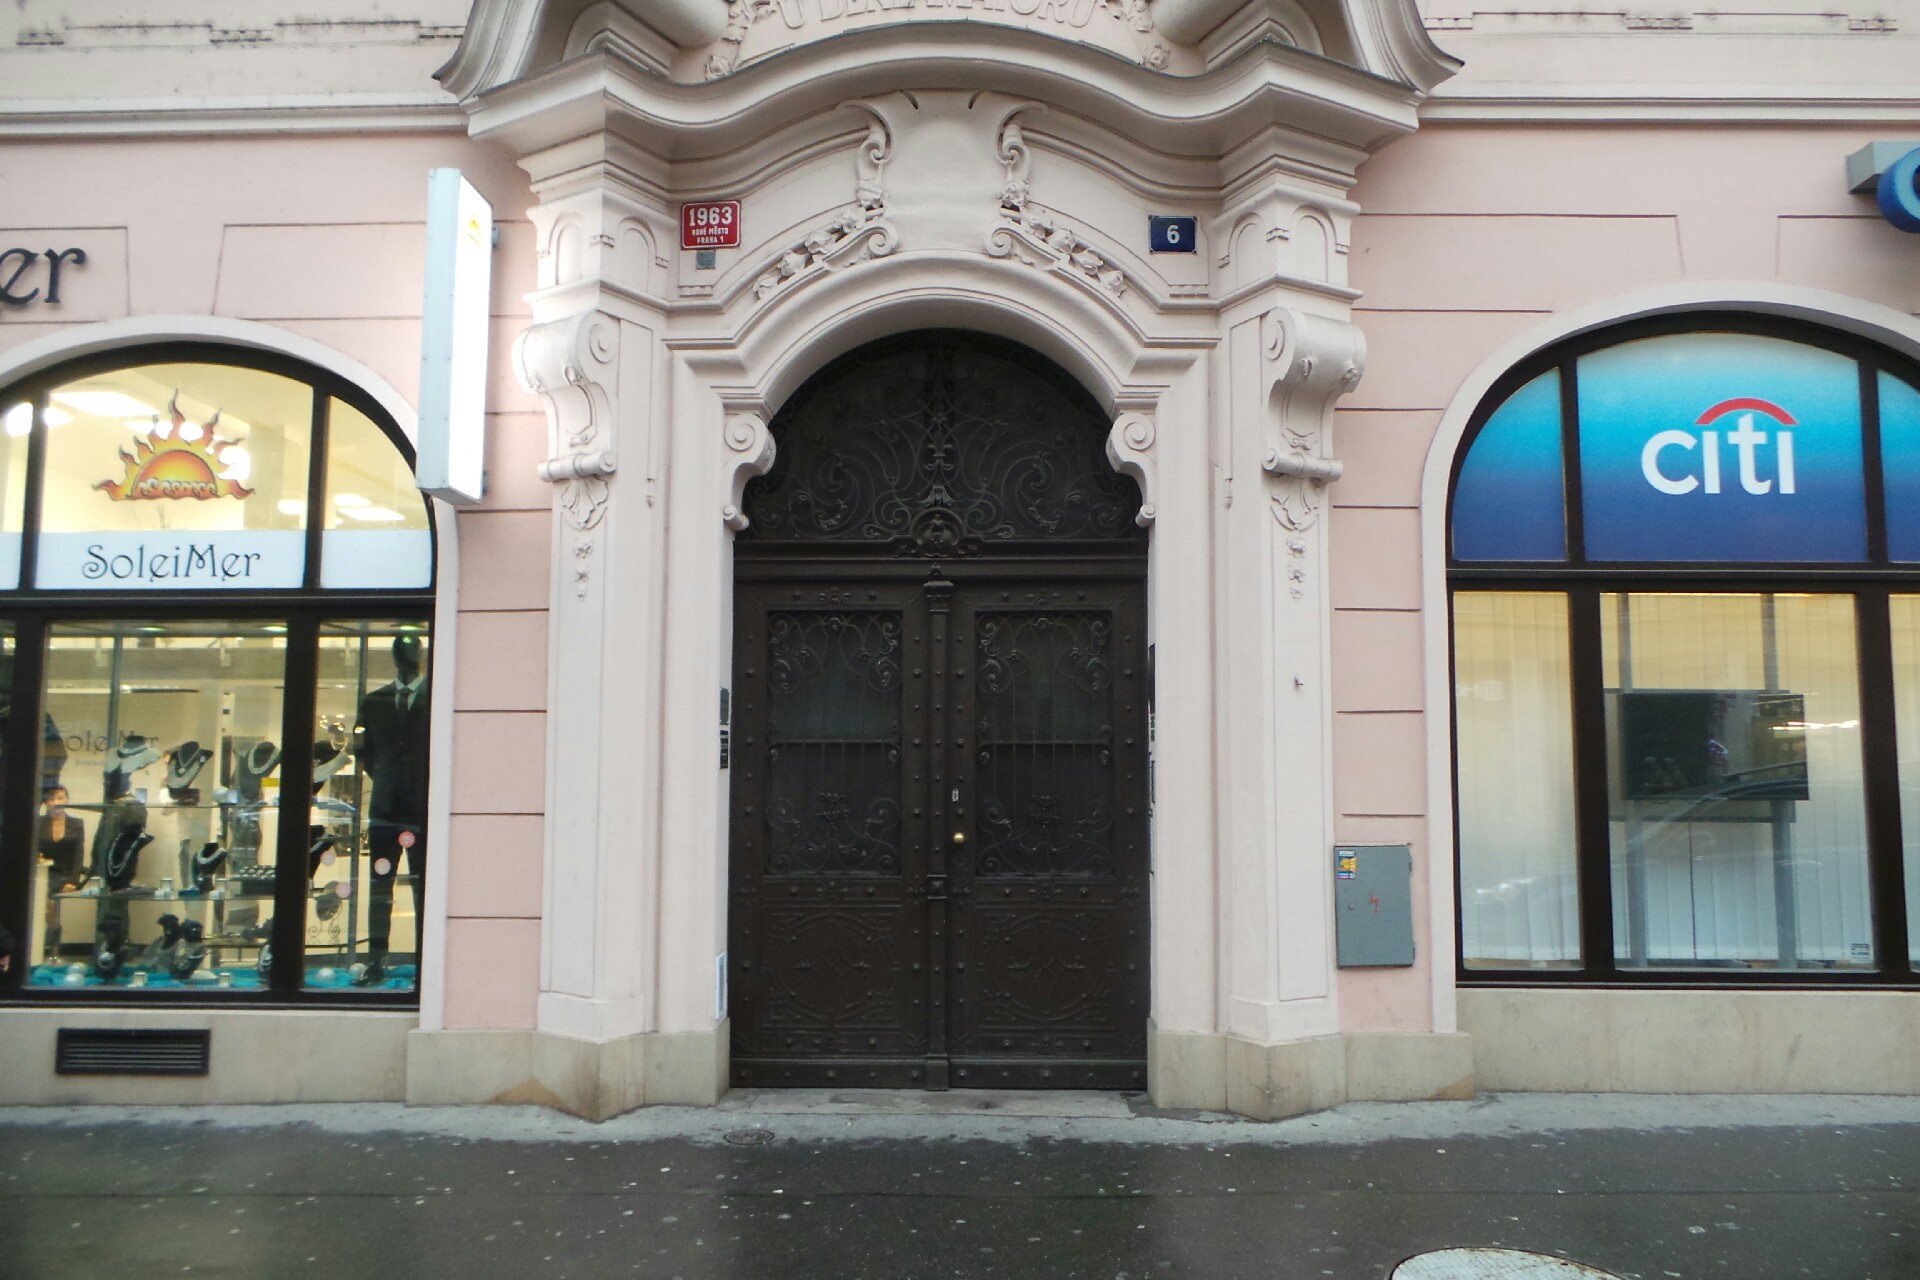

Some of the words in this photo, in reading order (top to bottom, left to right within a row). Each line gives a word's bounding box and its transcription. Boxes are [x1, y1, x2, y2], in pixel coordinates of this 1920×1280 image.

[689, 206, 733, 227] 1963
[691, 227, 707, 236] NOVÉ
[708, 226, 729, 235] MĚSTO
[697, 236, 718, 244] PRAHA
[1166, 224, 1180, 244] 6
[0, 247, 87, 305] er
[1641, 412, 1796, 495] citi
[82, 543, 261, 582] SoleiMer
